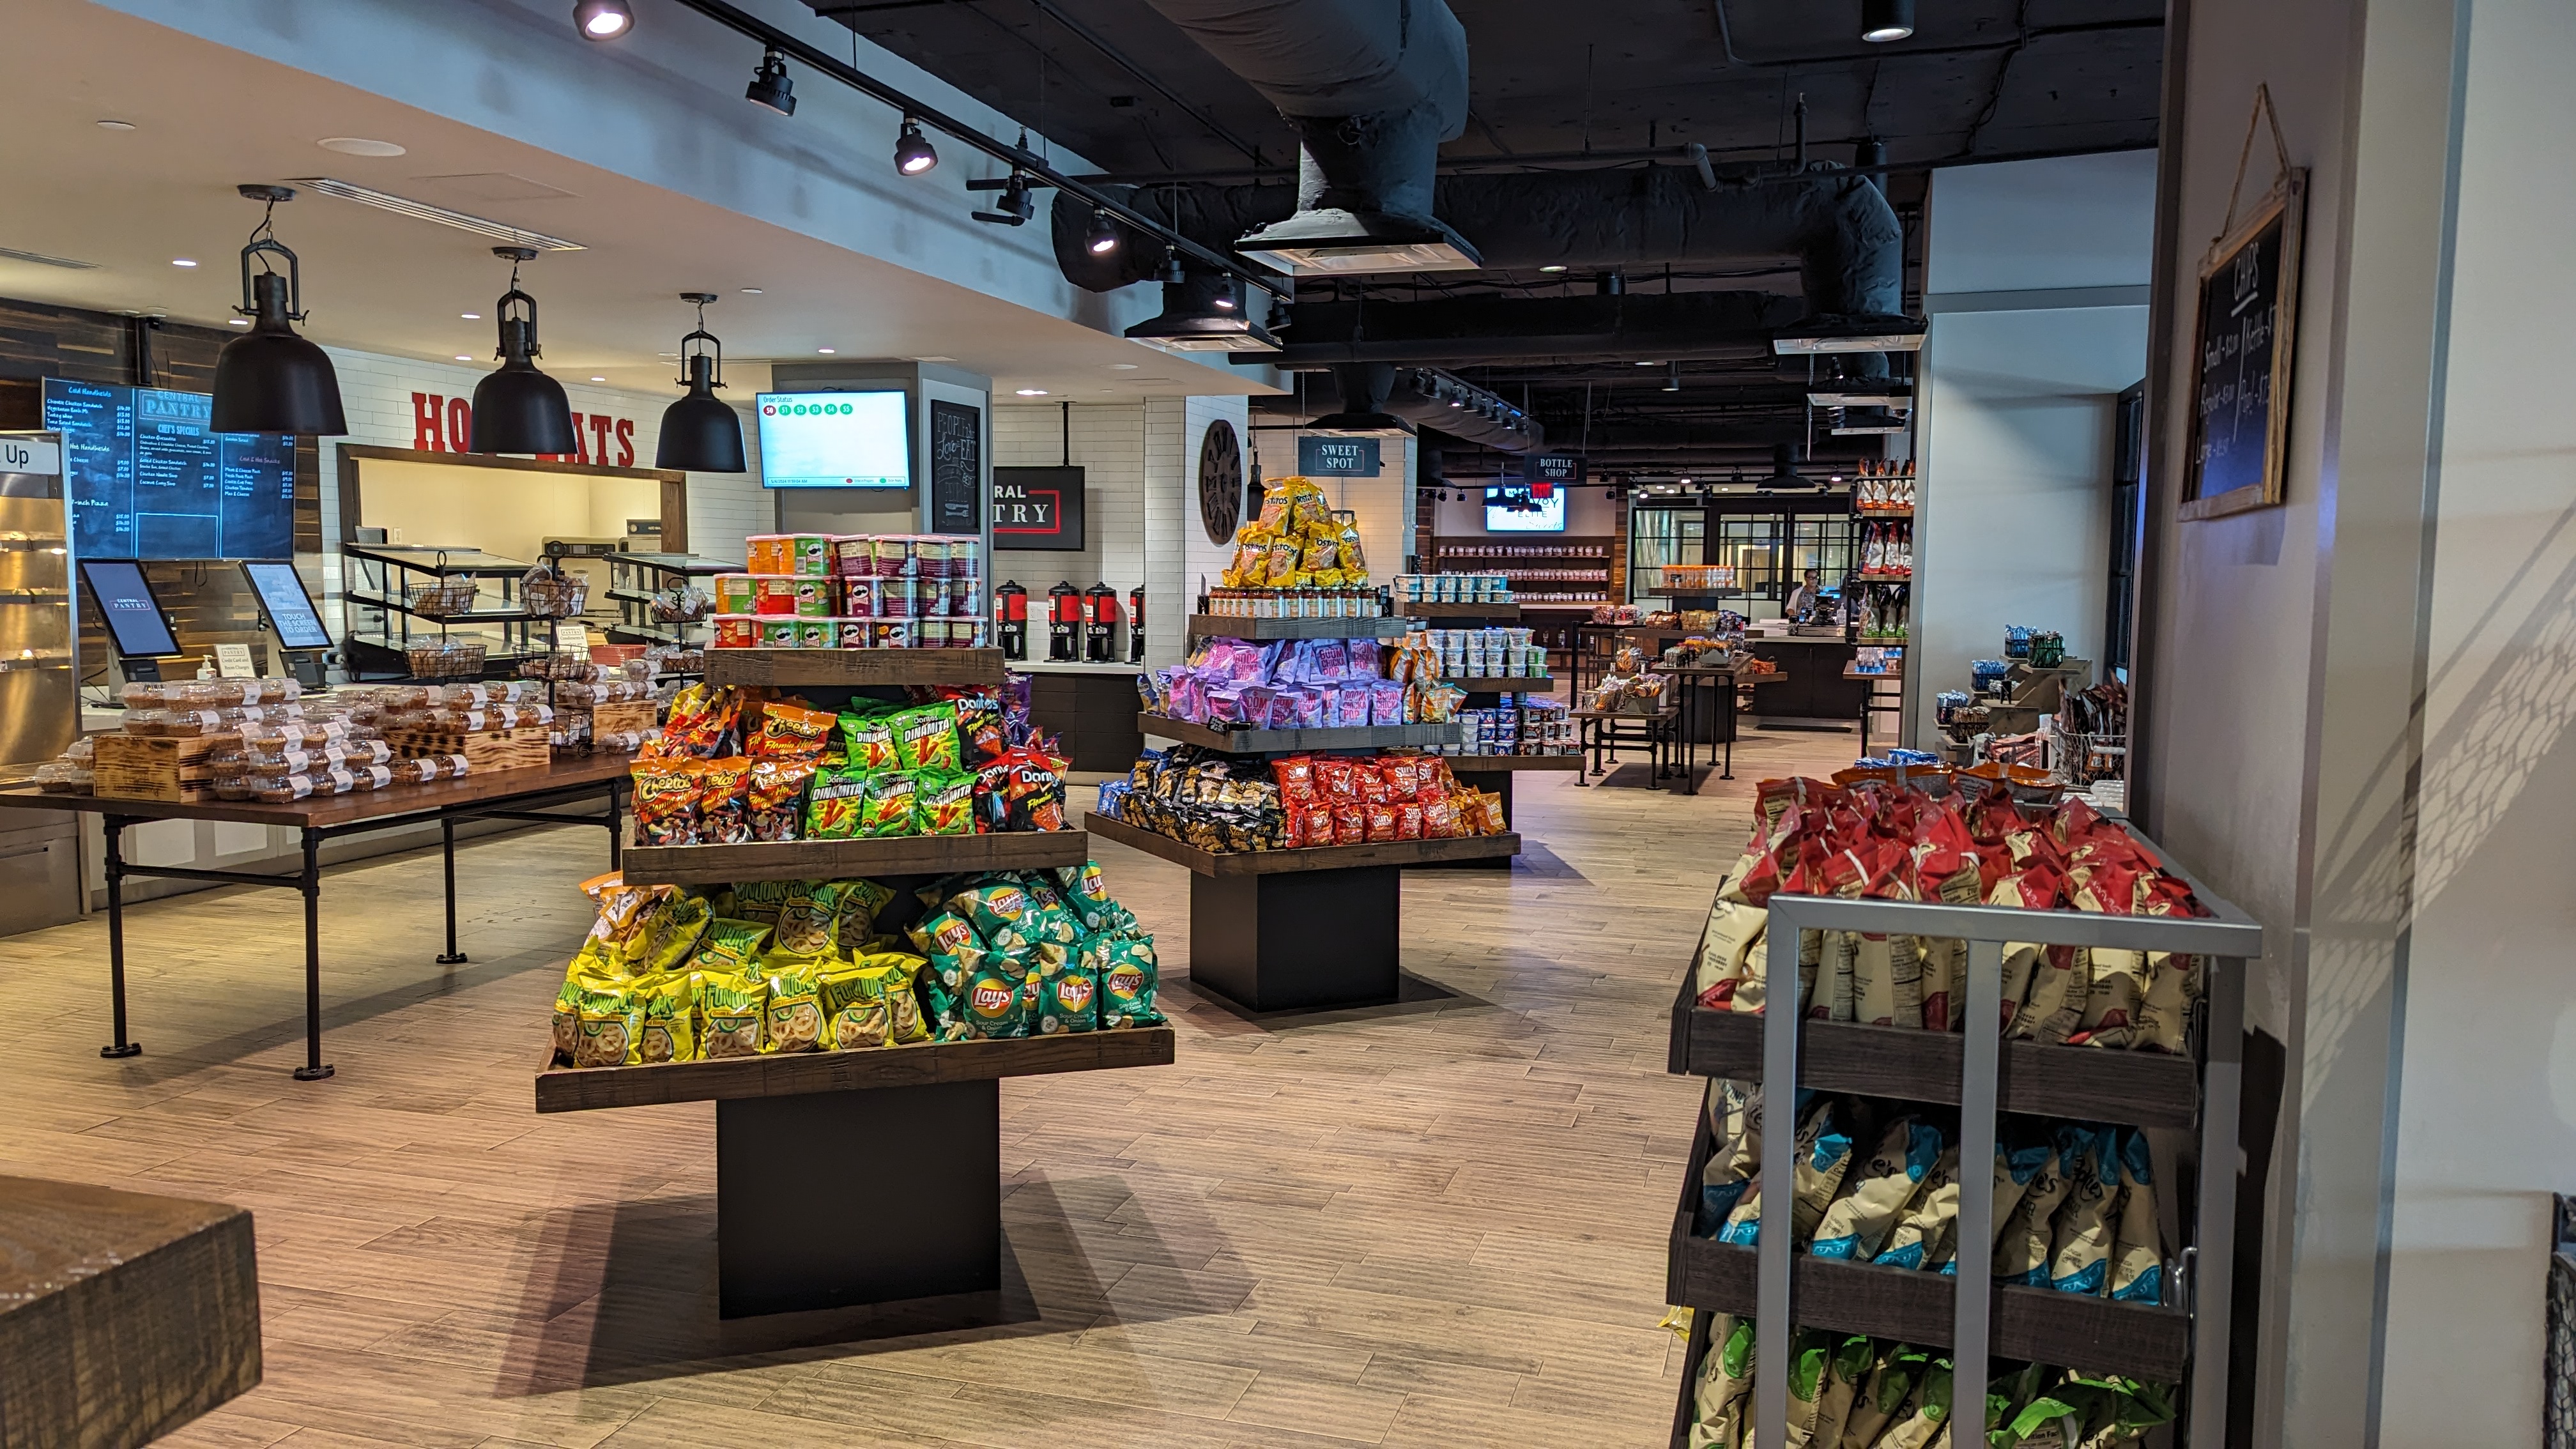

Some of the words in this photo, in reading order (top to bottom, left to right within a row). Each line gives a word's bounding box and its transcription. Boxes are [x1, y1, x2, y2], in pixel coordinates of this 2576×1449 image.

[157, 391, 200, 402] CENTRAL
[146, 400, 211, 418] PANTRY
[412, 392, 486, 455] HO
[937, 433, 958, 461] Love
[960, 439, 976, 461] EAT
[1321, 444, 1359, 456] SWEET
[5, 444, 29, 470] Up
[1327, 457, 1354, 469] SPOT
[1540, 458, 1573, 468] BOTTLE
[1545, 468, 1568, 477] SHOP
[994, 485, 1027, 498] RAL
[992, 503, 1049, 523] TRY
[1320, 647, 1344, 659] BOOM
[1321, 657, 1346, 668] CHICKA
[1322, 666, 1340, 677] POP
[957, 697, 999, 712] Doritos
[913, 715, 939, 725] Doritos
[1344, 709, 1360, 720] POP
[1376, 709, 1393, 719] POP
[765, 716, 821, 739] Cheetos
[903, 717, 952, 744] DINAMITA
[856, 728, 893, 744] DINAMIT
[796, 740, 813, 749] Hot
[978, 765, 1009, 783] Dorito
[1395, 765, 1416, 778] Sun
[704, 770, 737, 790] eetos
[825, 775, 852, 784] Doritos
[884, 776, 909, 785] Doritos
[640, 773, 693, 802] Cheetos
[717, 787, 734, 799] Hot
[811, 781, 864, 801] DINAMITA
[1406, 807, 1421, 818] Sun
[1428, 802, 1448, 816] Sun
[1374, 815, 1390, 827] Sun
[1229, 824, 1251, 838] Stacy's
[1256, 825, 1271, 833] acy's
[992, 889, 1023, 914] Lay's
[937, 921, 970, 953] Lay's
[1112, 974, 1143, 992] Lay's
[832, 976, 885, 1008] FUNYUN
[974, 988, 1012, 1010] Lay's
[1061, 982, 1094, 1004] Lay's
